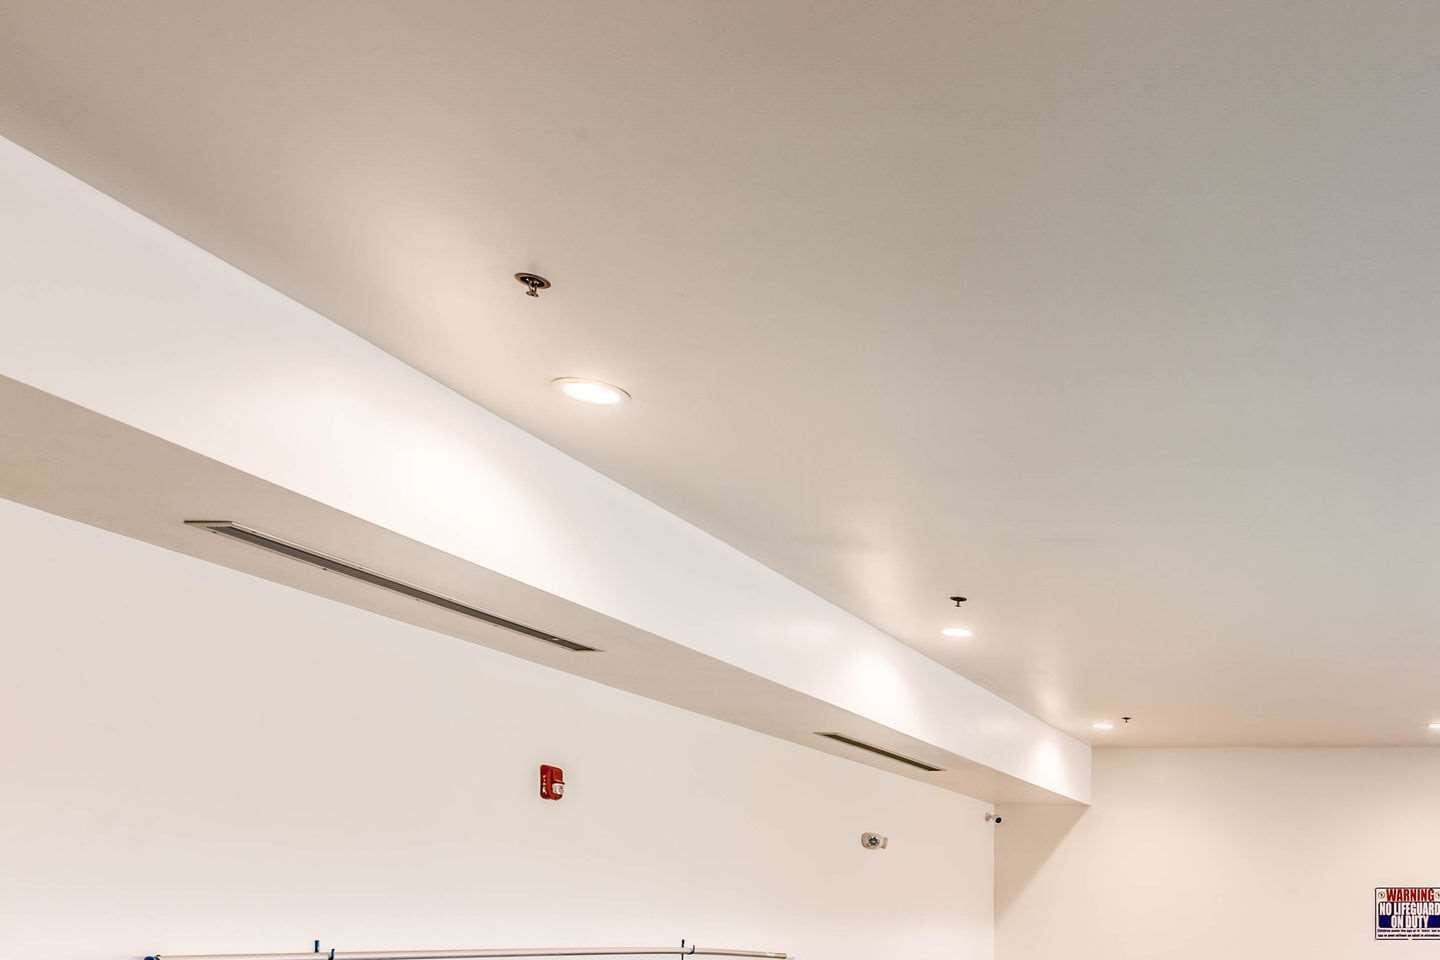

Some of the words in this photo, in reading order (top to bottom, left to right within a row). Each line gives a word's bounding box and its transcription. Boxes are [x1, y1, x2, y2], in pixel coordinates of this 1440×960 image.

[1386, 888, 1435, 902] WARNING
[1379, 902, 1392, 915] NO
[1393, 902, 1440, 916] LIFEGUARD
[1391, 915, 1404, 928] ON
[1405, 915, 1429, 928] DUTY
